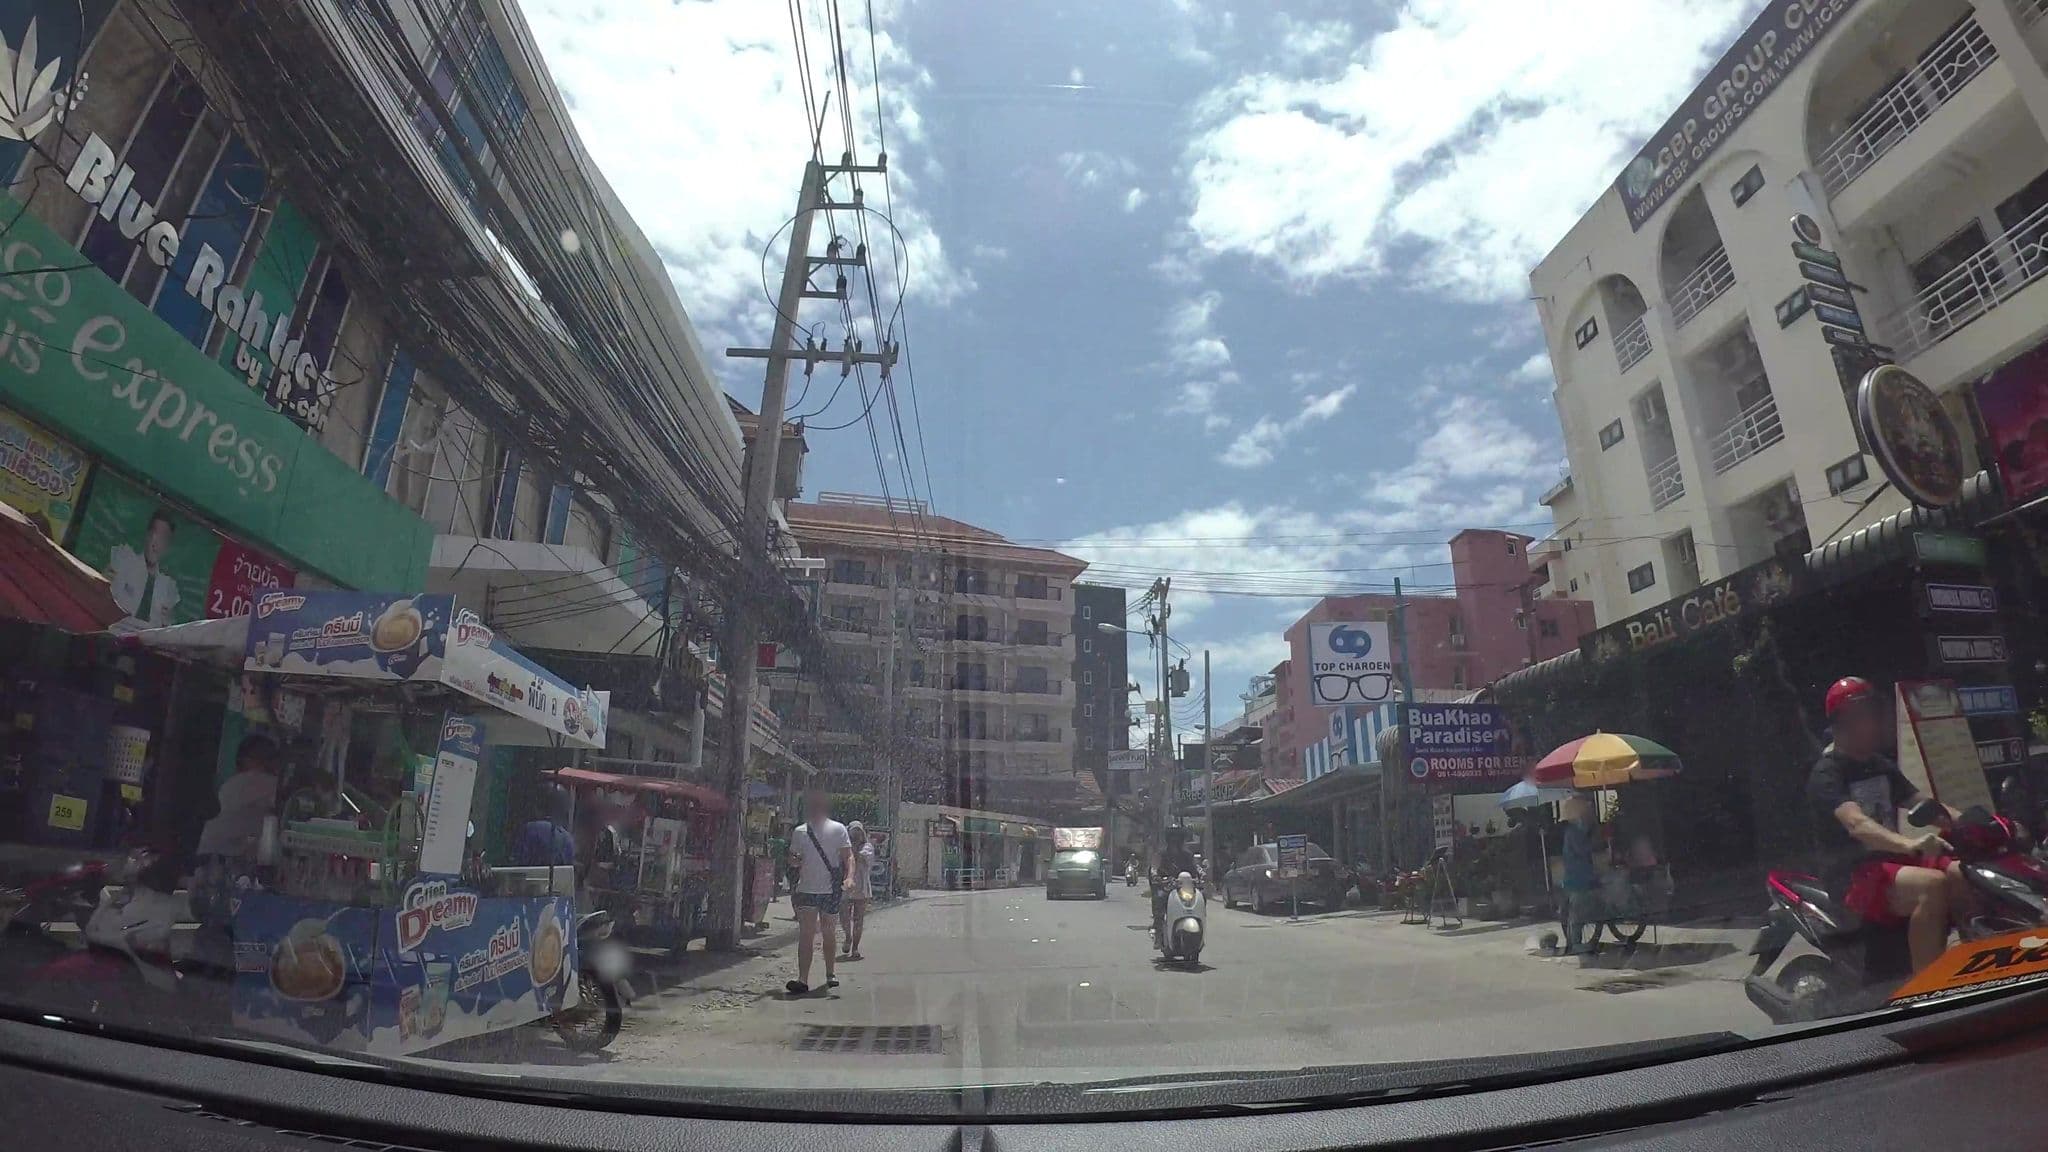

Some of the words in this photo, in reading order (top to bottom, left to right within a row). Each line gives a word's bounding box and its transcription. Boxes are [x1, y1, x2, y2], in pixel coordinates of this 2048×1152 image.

[1657, 117, 1698, 173] GBP
[1703, 29, 1778, 121] GROUP
[65, 131, 180, 266] Blue
[236, 341, 263, 388] by
[71, 314, 283, 492] express
[323, 612, 364, 635] ครีมมี่
[1625, 609, 1677, 650] Bali
[1682, 581, 1742, 630] Café
[457, 624, 492, 646] Dreamy
[1314, 661, 1336, 672] TOP
[1338, 660, 1391, 672] CHAROEN
[1408, 708, 1492, 726] BuaKhao
[1410, 727, 1493, 744] Paradise
[1430, 757, 1474, 770] ROOMS
[1477, 756, 1501, 768] FOR
[54, 805, 73, 818] 259
[399, 895, 477, 949] Dreamy
[489, 916, 520, 957] ครีมมี่
